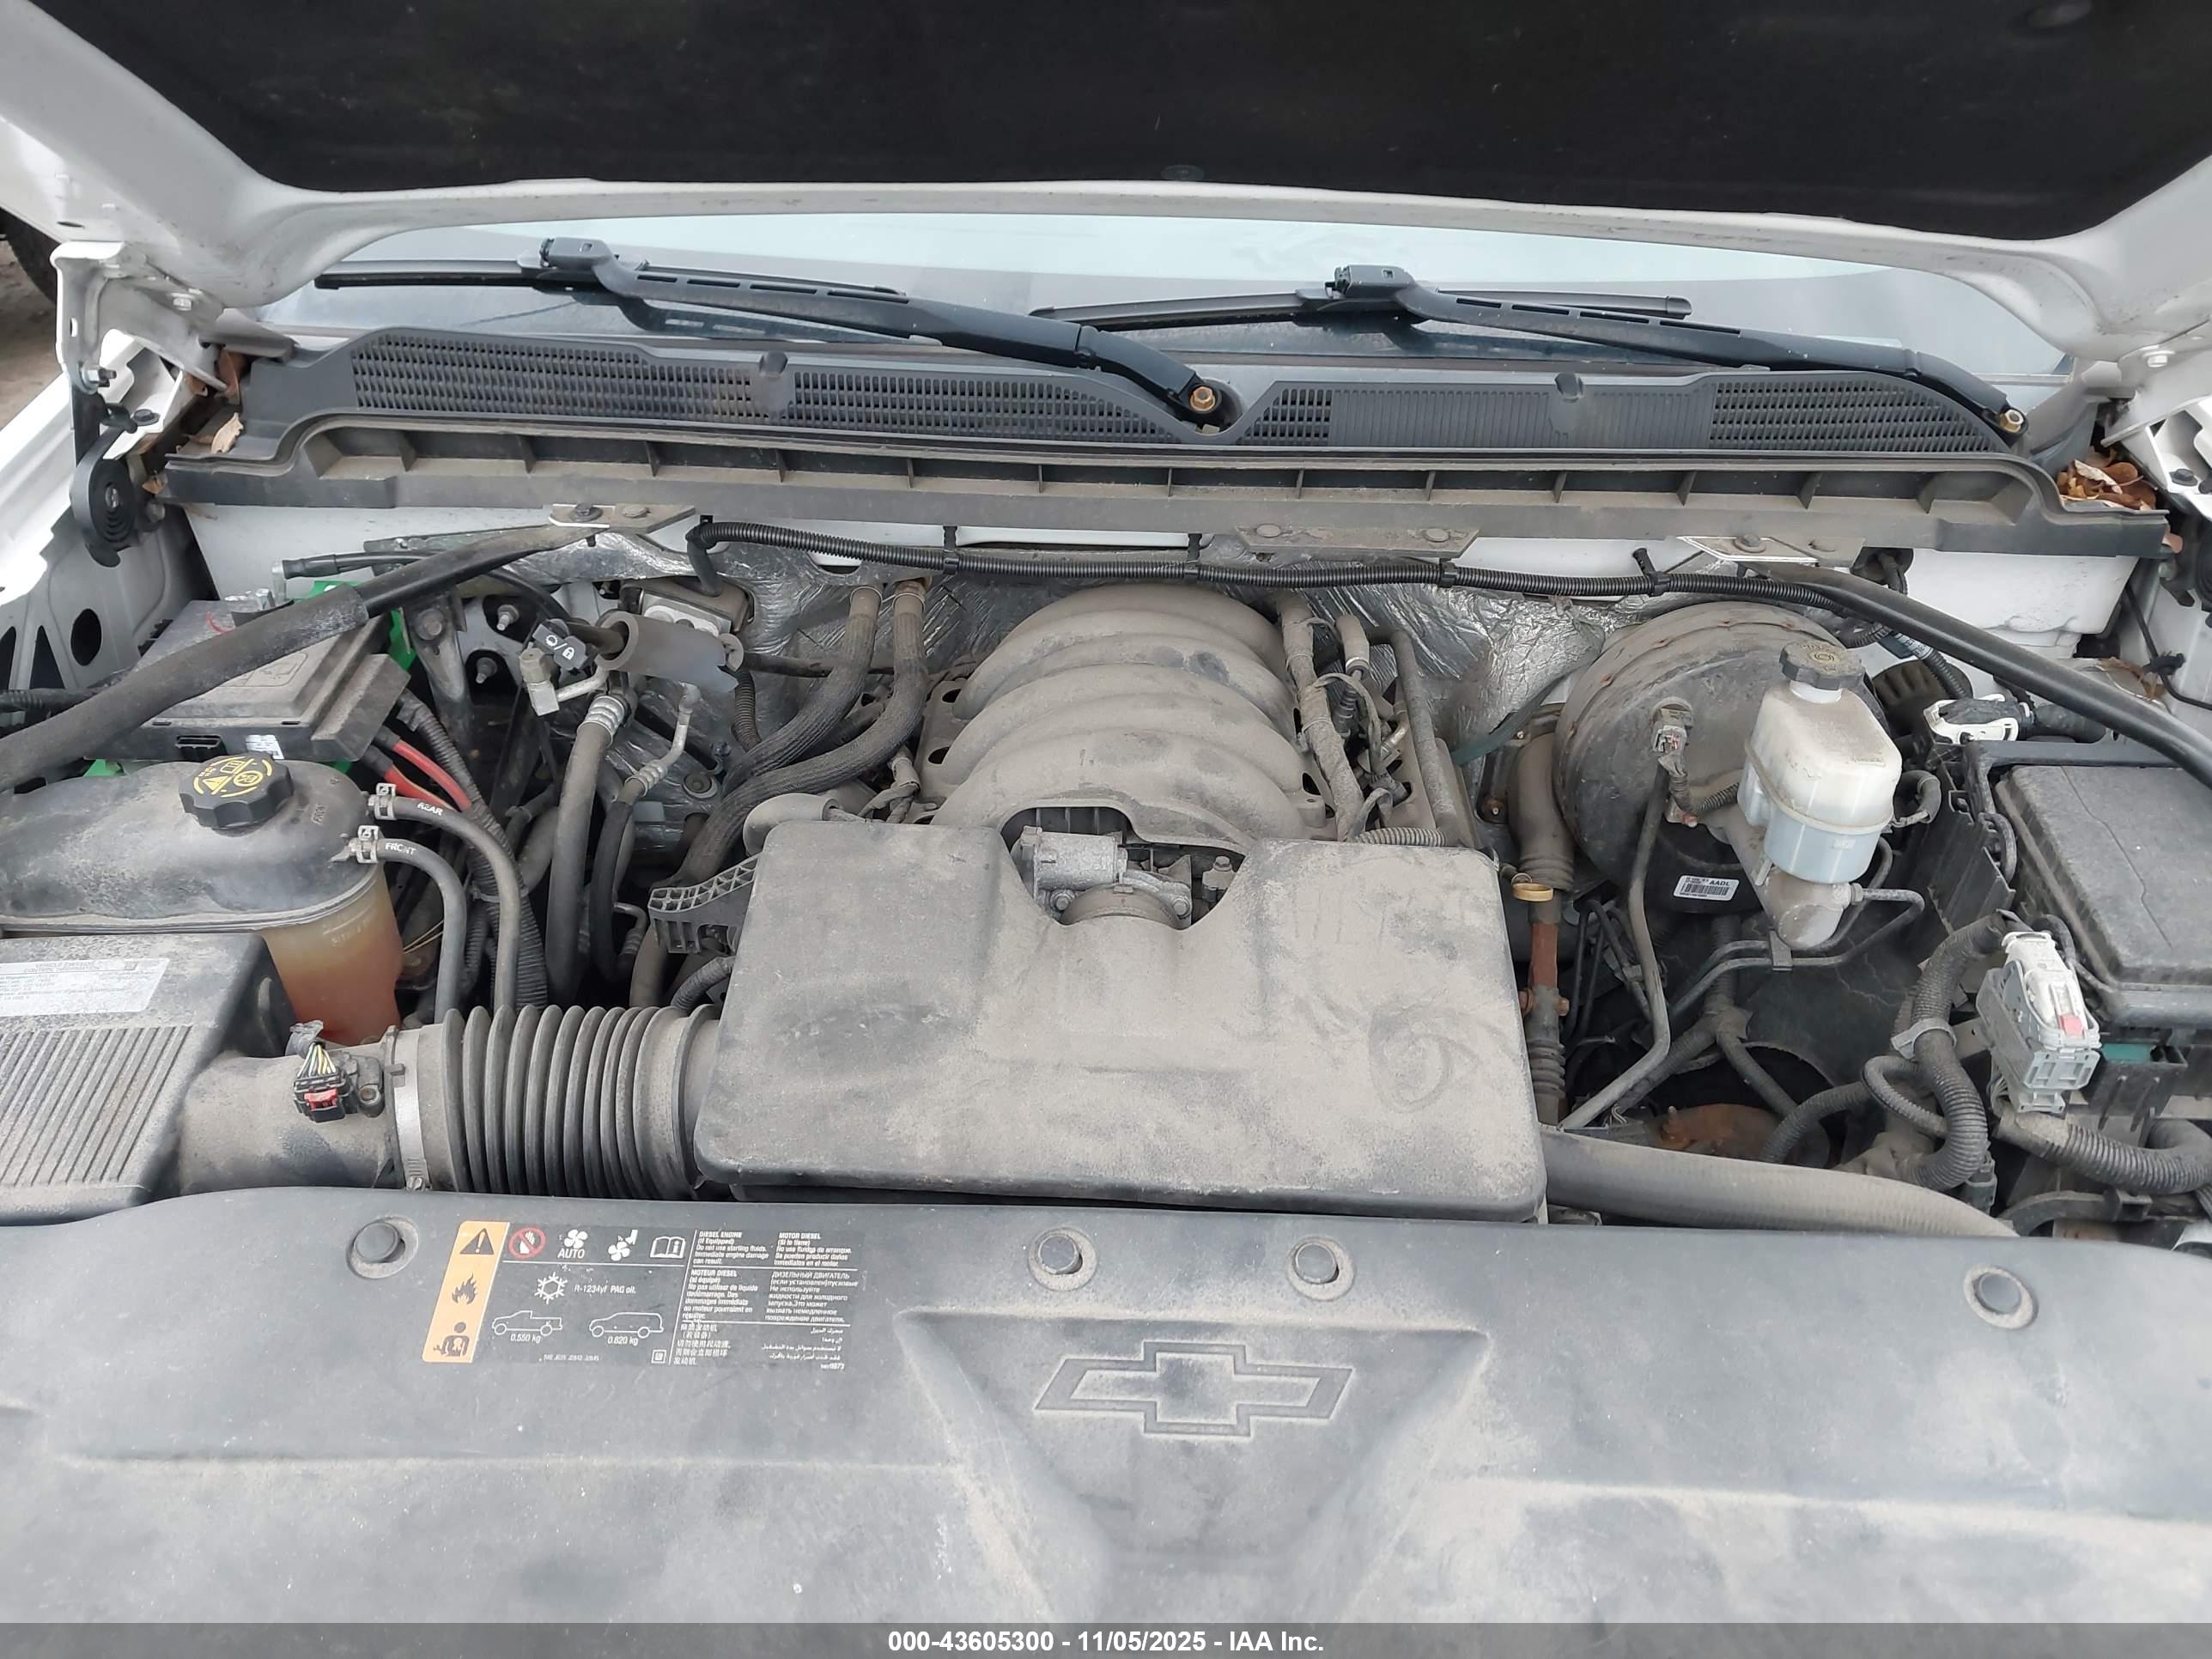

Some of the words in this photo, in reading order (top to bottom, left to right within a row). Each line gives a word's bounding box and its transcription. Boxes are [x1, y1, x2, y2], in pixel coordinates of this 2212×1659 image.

[385, 842, 417, 854] FRONT
[556, 1249, 586, 1259] AUTO
[532, 1334, 541, 1344] kg
[629, 1335, 639, 1346] kg
